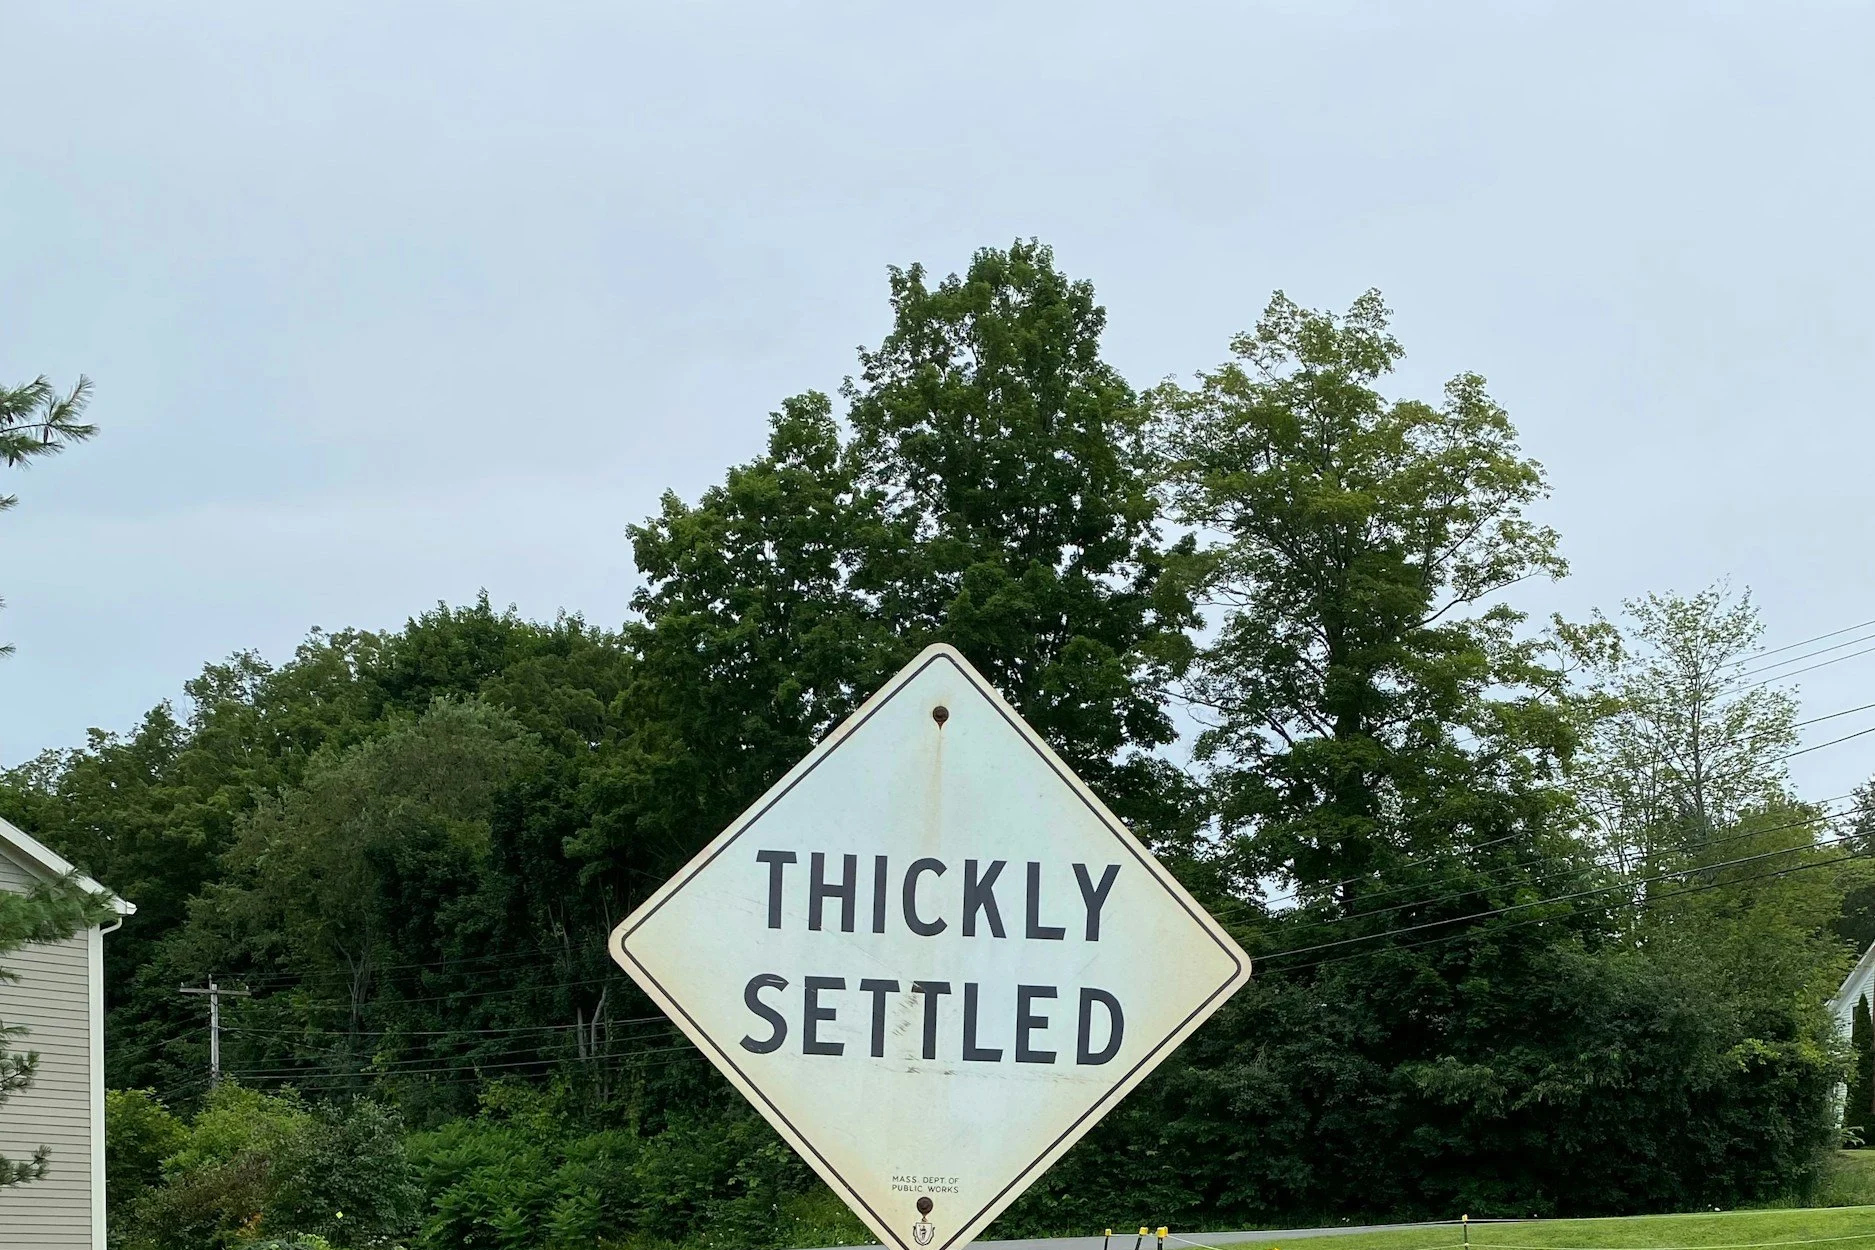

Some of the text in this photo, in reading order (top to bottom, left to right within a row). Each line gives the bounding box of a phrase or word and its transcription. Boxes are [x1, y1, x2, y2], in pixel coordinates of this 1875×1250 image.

[755, 849, 1121, 942] THICKLY
[739, 973, 1124, 1066] SETTLED
[892, 1184, 959, 1194] PUBLIC WORKS
[948, 1177, 959, 1185] OF
